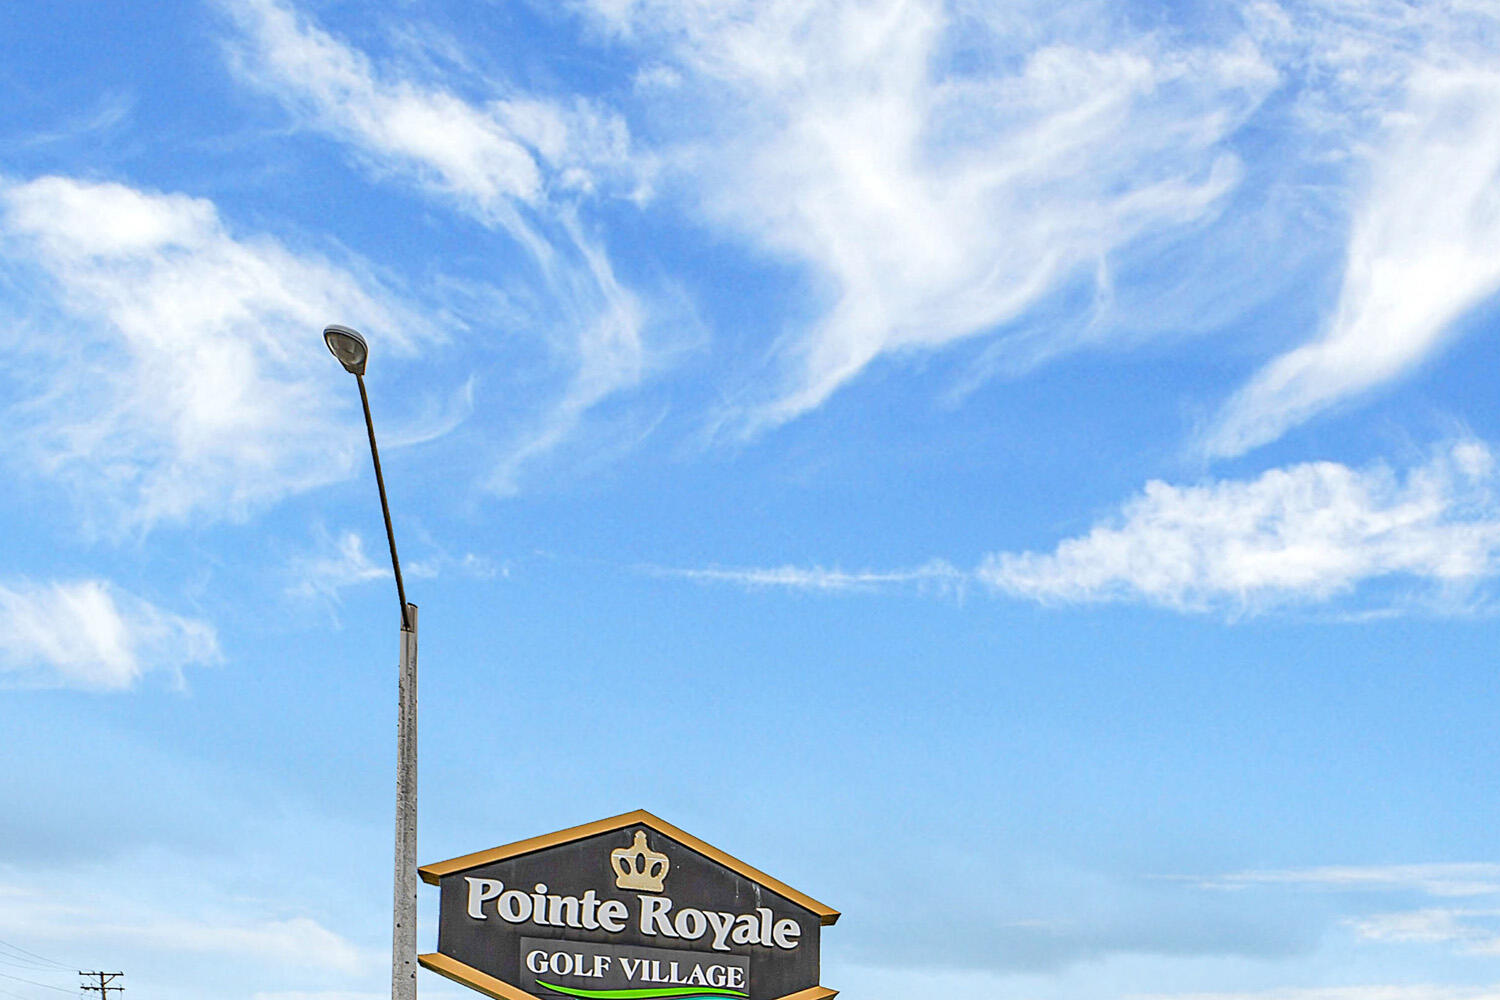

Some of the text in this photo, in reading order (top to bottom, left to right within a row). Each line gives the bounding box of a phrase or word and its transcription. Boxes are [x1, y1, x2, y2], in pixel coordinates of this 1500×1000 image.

[464, 876, 802, 951] Pointe Royale
[526, 950, 746, 990] GOLF VILLAGE
